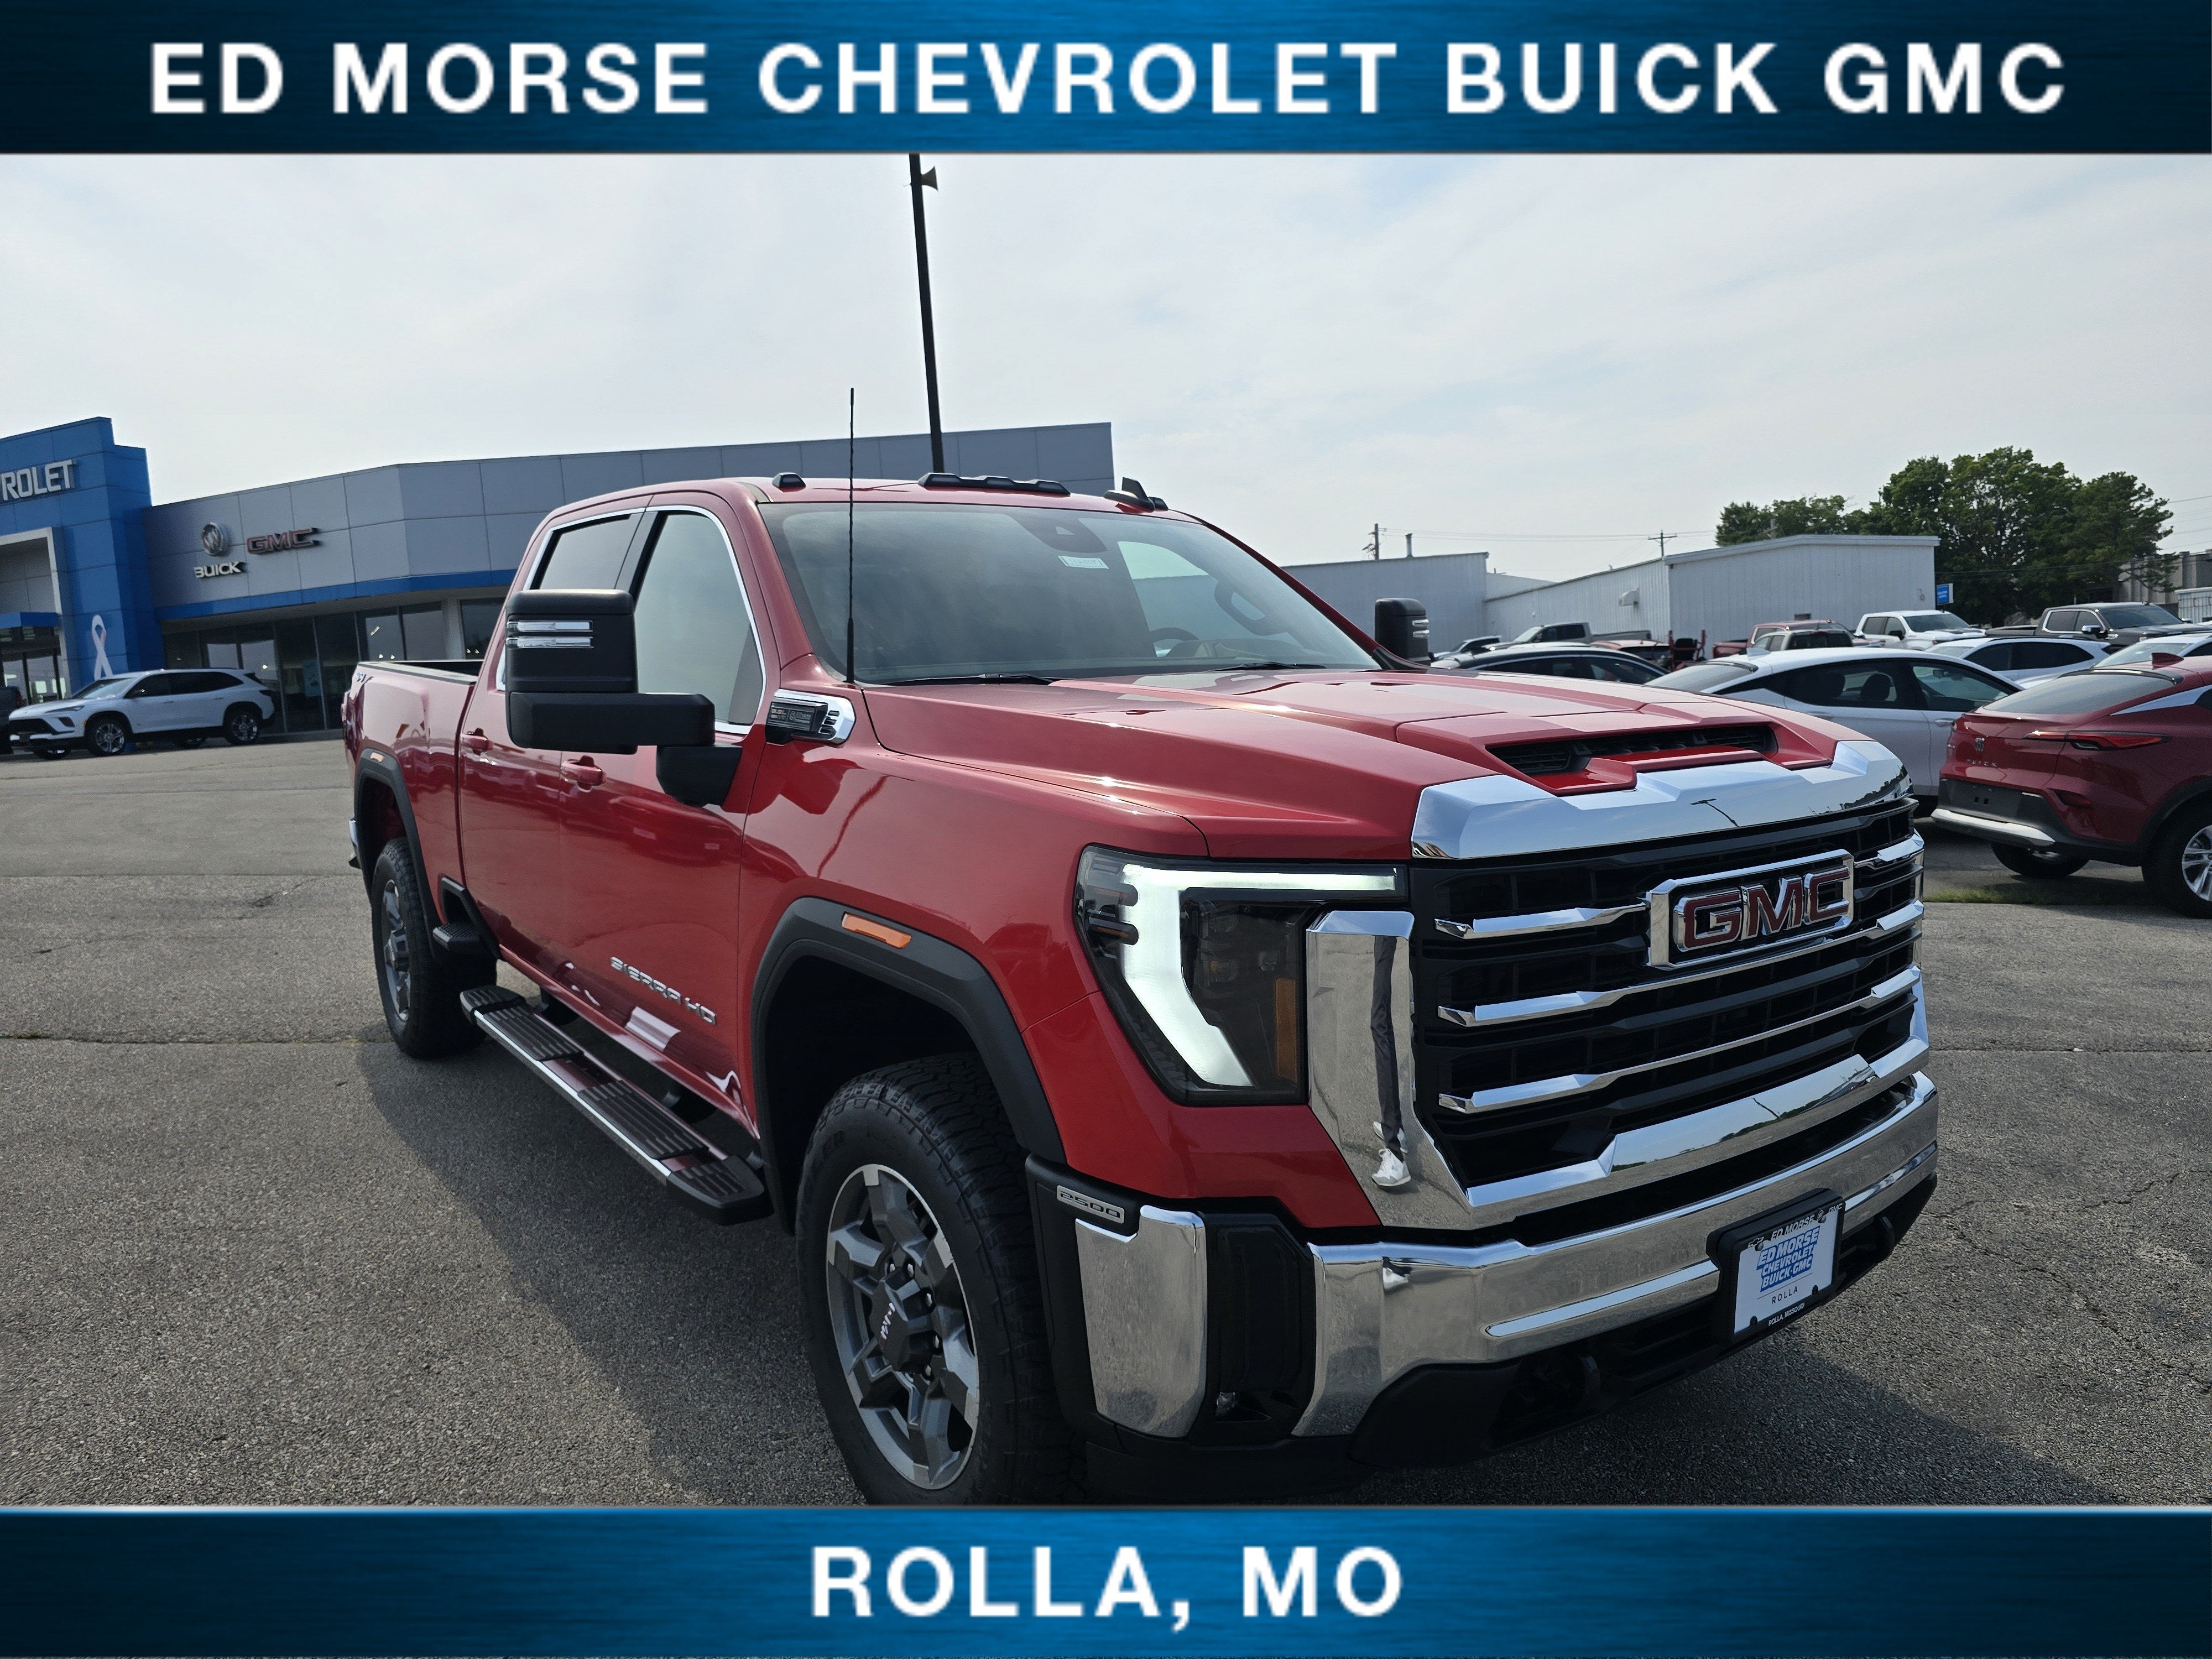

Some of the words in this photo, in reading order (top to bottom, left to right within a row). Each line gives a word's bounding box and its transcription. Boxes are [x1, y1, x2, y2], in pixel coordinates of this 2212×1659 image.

[247, 529, 311, 554] GMC
[194, 561, 241, 578] BUICK
[1673, 864, 1850, 952] GMC
[611, 956, 681, 1004] SIERRA
[684, 997, 716, 1025] HD
[1060, 1191, 1120, 1218] 2500
[1771, 1228, 1783, 1241] ED
[1784, 1214, 1815, 1236] MORSE
[1759, 1246, 1776, 1266] ED
[1776, 1227, 1819, 1259] MORSE
[1762, 1244, 1814, 1276] CHEVROLET
[1772, 1286, 1798, 1305] ROLLA
